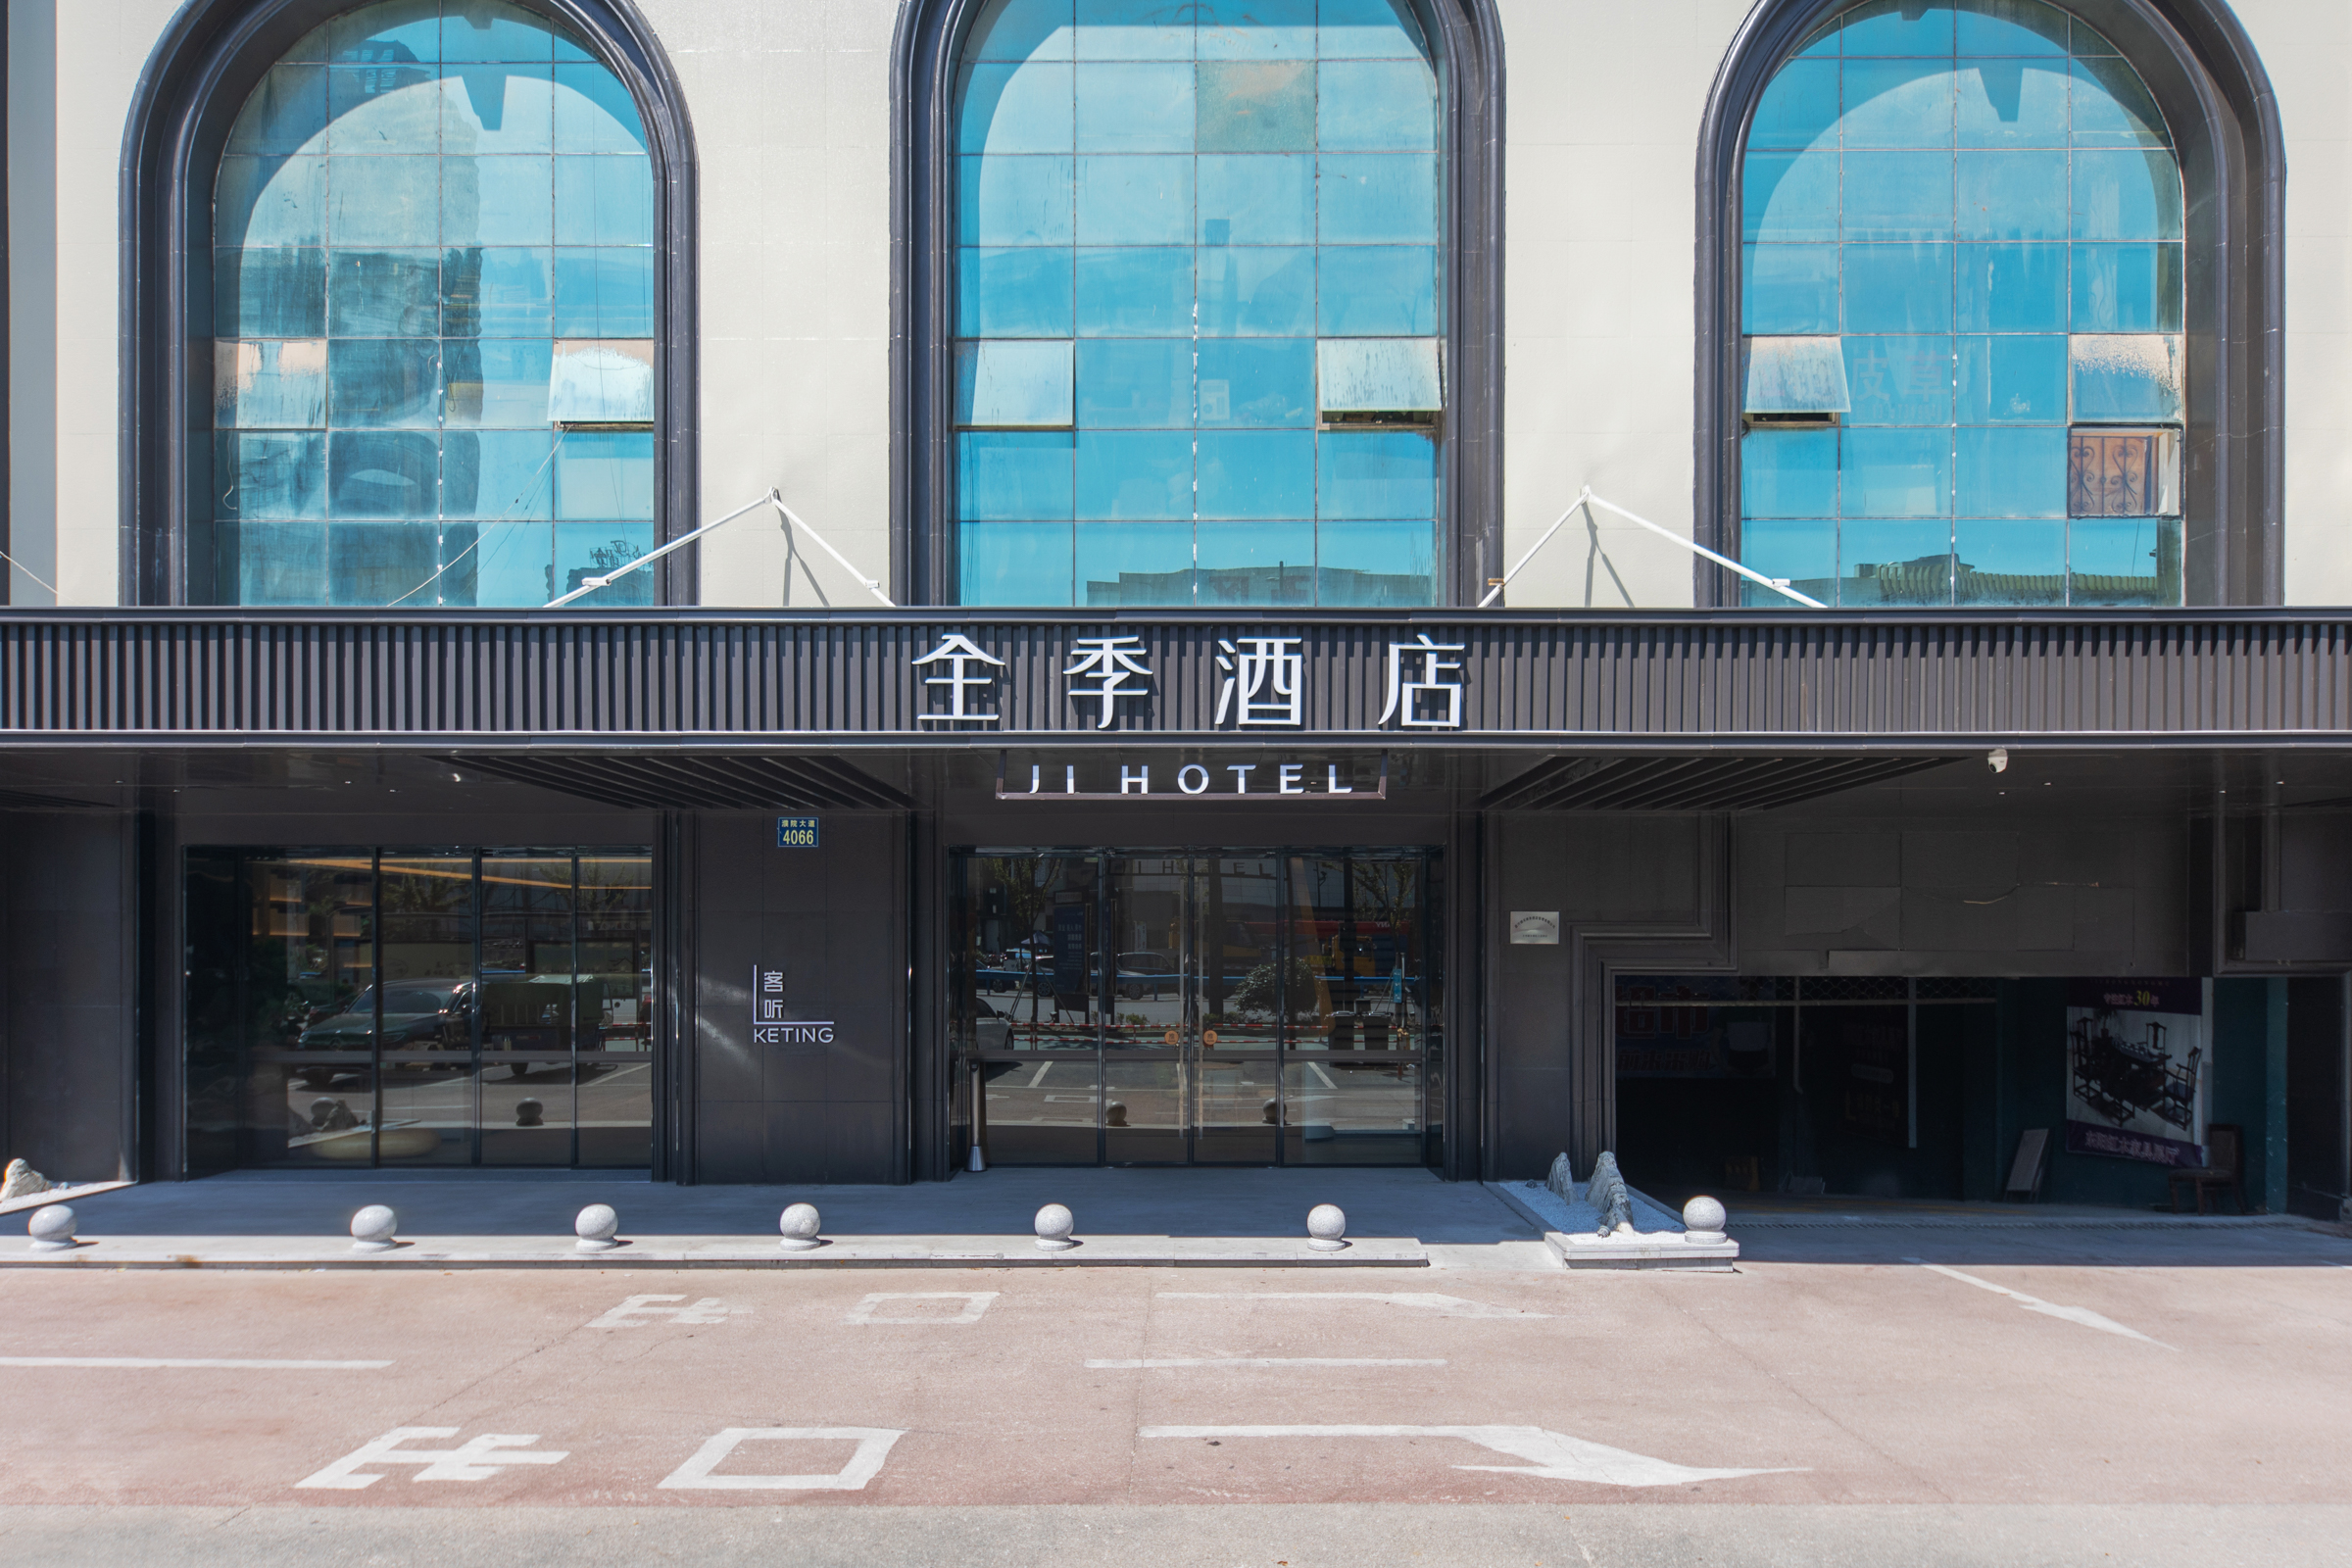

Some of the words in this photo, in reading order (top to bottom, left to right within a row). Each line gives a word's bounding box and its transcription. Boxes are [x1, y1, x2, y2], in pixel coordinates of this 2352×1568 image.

[911, 633, 1466, 729] 全季酒店
[1029, 764, 1075, 794] JI
[1120, 763, 1352, 794] HOTEL
[783, 829, 814, 845] 4066
[763, 970, 784, 1019] 客听
[754, 1027, 835, 1044] KETING
